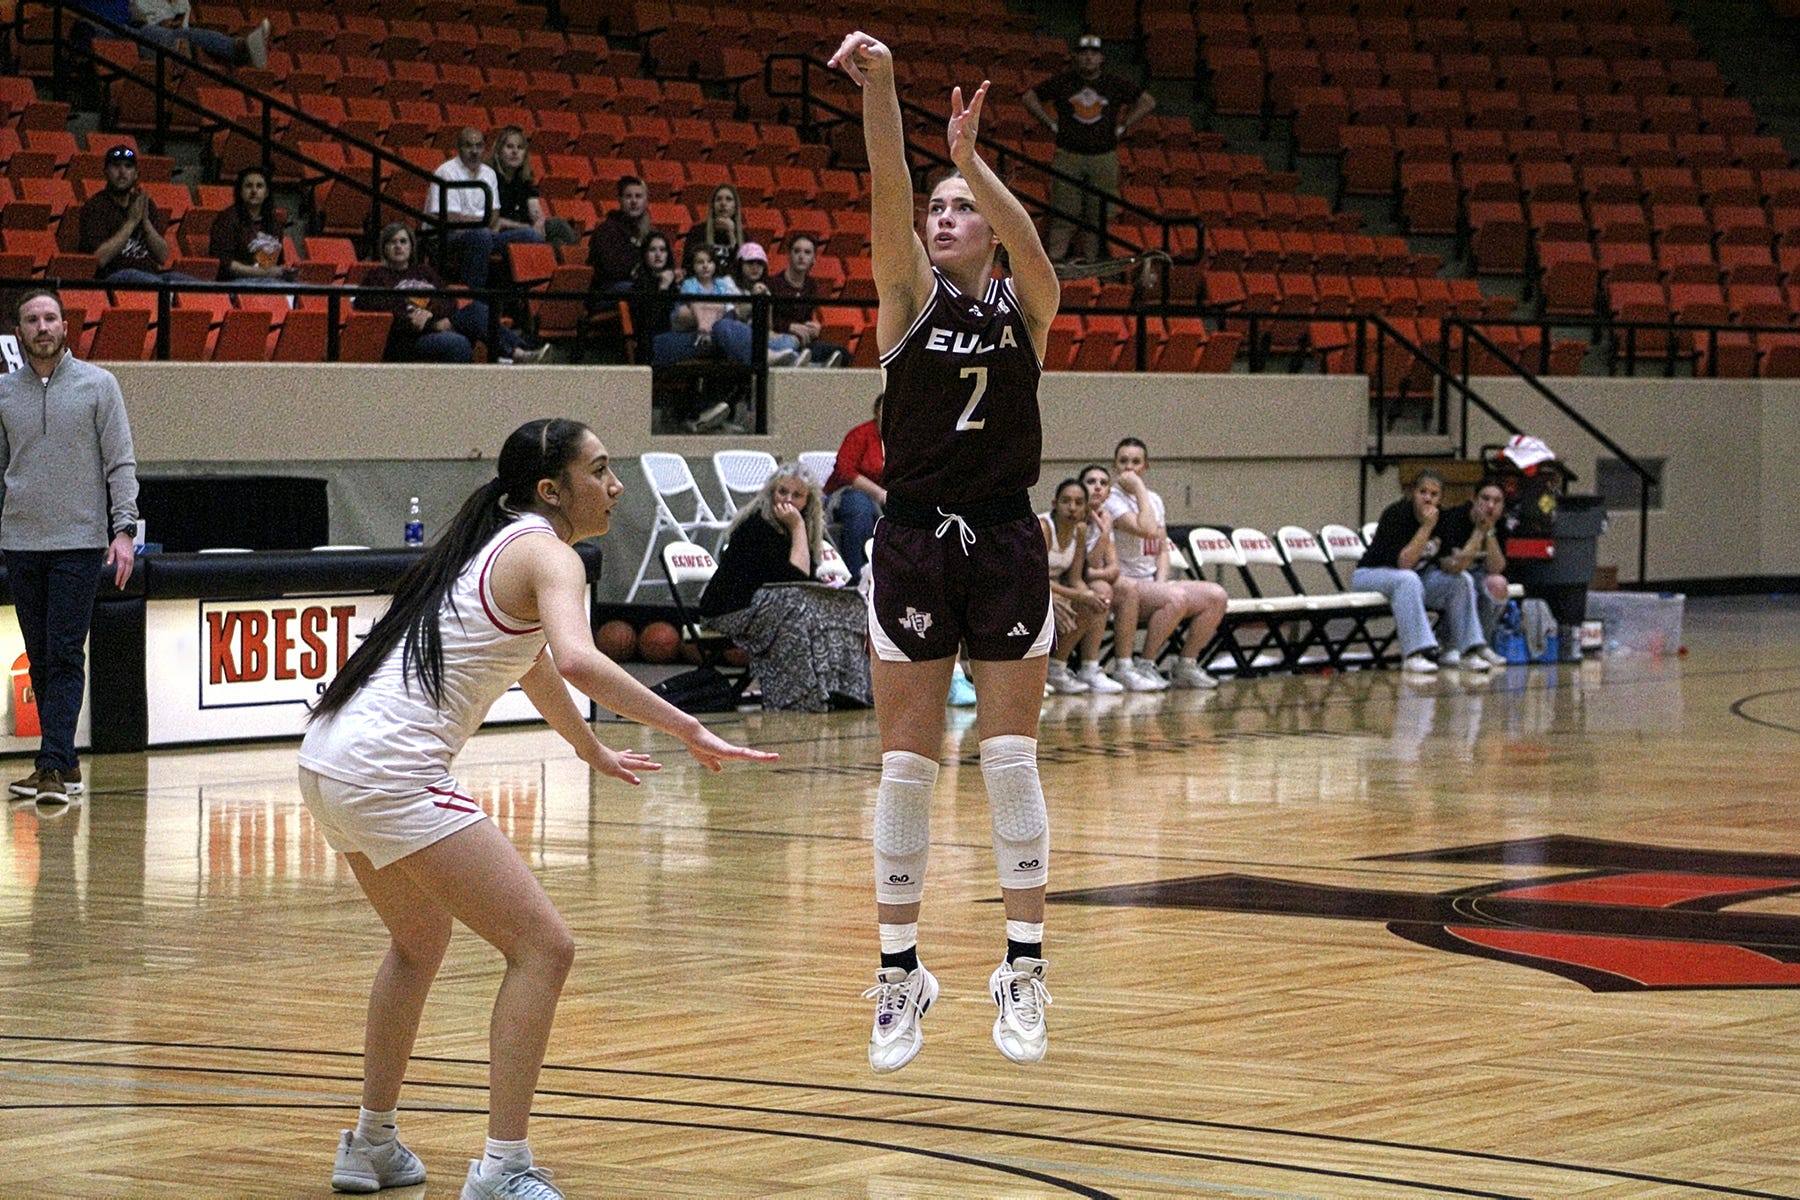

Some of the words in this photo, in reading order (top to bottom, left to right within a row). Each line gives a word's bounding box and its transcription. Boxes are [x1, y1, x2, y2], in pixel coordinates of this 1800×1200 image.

[925, 325, 1018, 354] EULA
[955, 366, 988, 431] 2
[206, 604, 356, 685] KBEST
